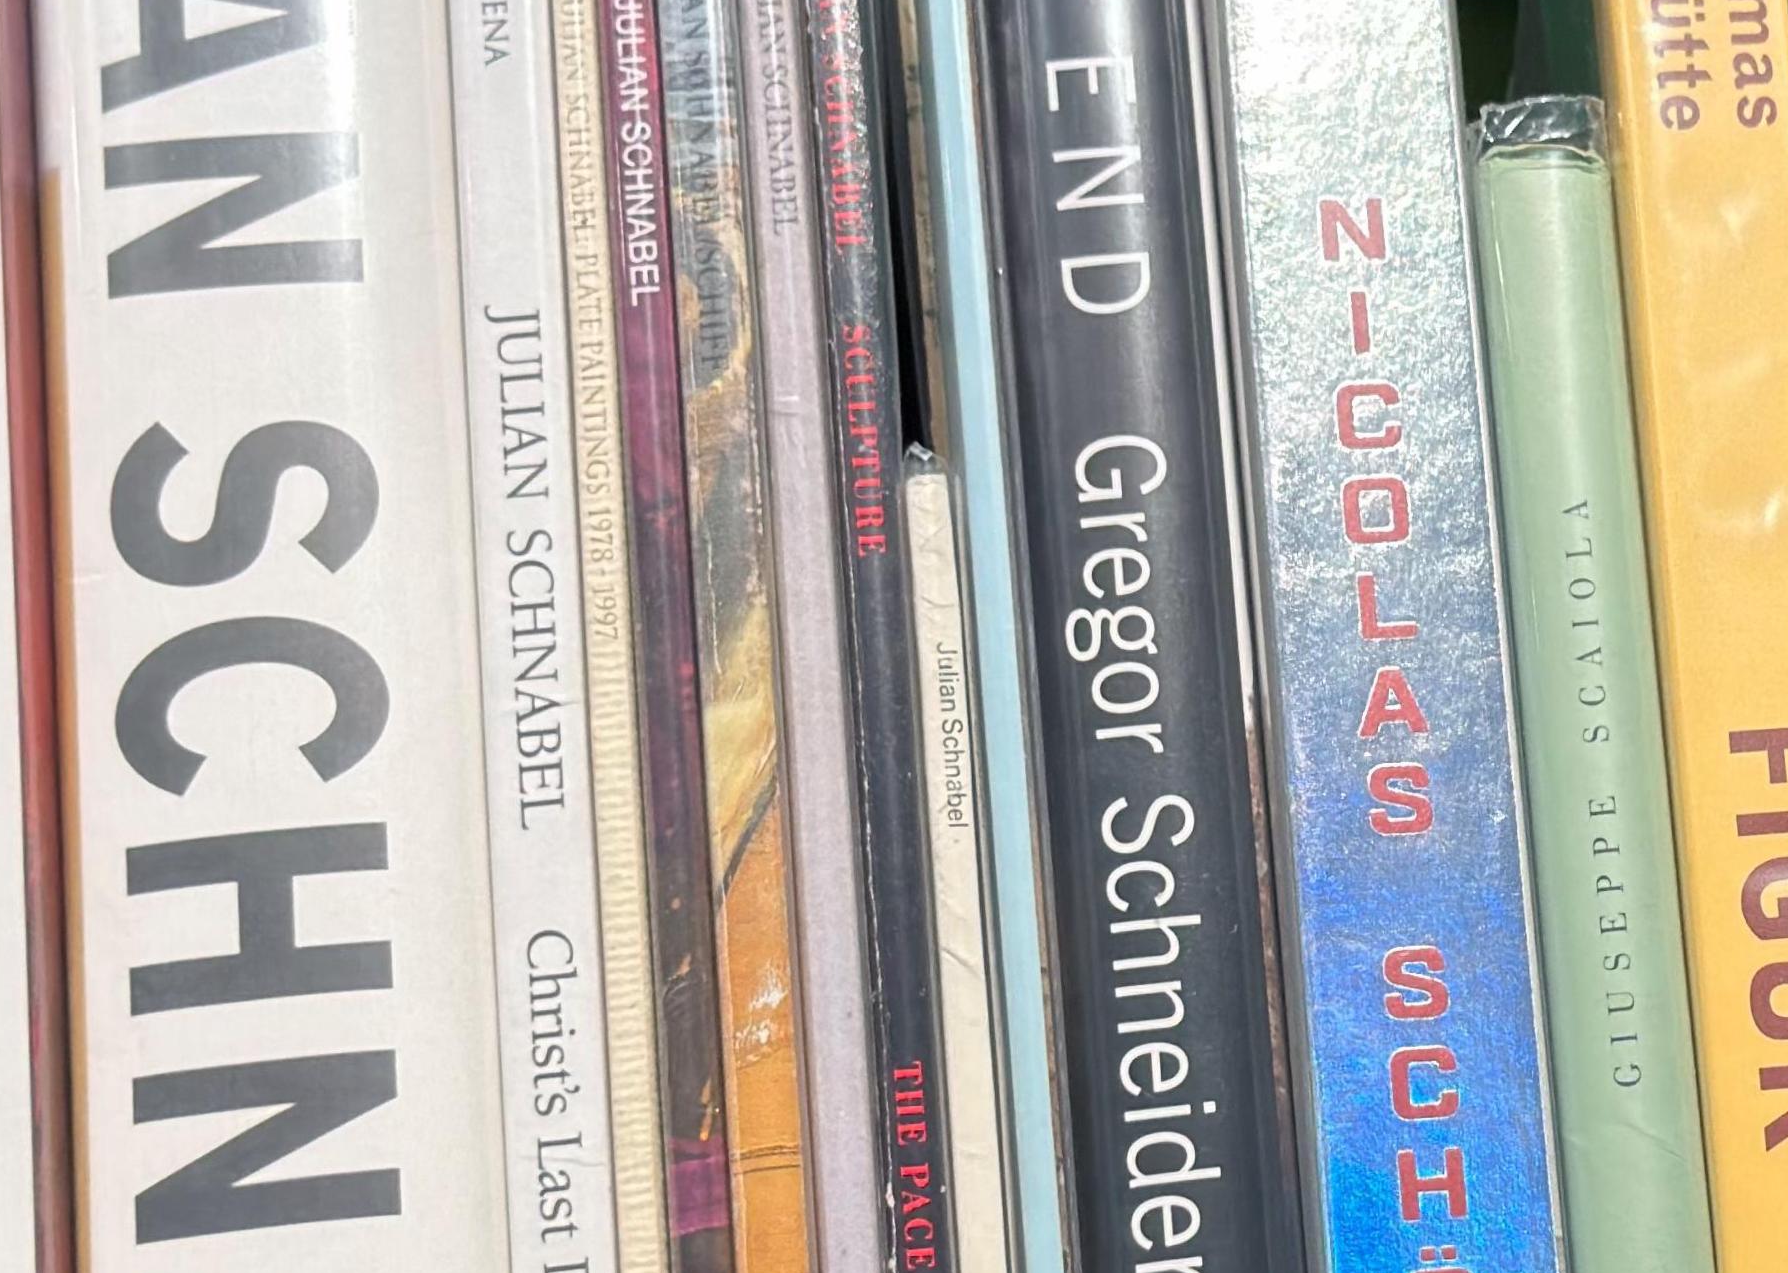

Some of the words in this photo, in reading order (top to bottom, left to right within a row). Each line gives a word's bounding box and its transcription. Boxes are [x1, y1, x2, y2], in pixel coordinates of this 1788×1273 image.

[622, 121, 661, 306] SCHNABEL
[763, 61, 800, 236] SCHNABEL
[822, 54, 867, 252] SCHNABEL
[1044, 56, 1151, 315] END
[574, 253, 604, 329] PLATE
[485, 306, 549, 499] JULIAN
[578, 342, 612, 496] PAINTINGS
[843, 325, 887, 559] SCULPTURE
[1066, 432, 1168, 755] Gregor
[1319, 197, 1434, 838] NICOLAS
[506, 529, 566, 831] SCHNABEL
[935, 642, 964, 712] Julian
[1561, 497, 1611, 745] SCAIOLA
[940, 718, 969, 828] Schnabel
[1587, 793, 1643, 1088] GIUSEPPE
[536, 1132, 585, 1243] Last
[893, 1061, 927, 1147] THE
[900, 1163, 936, 1269] PACE
